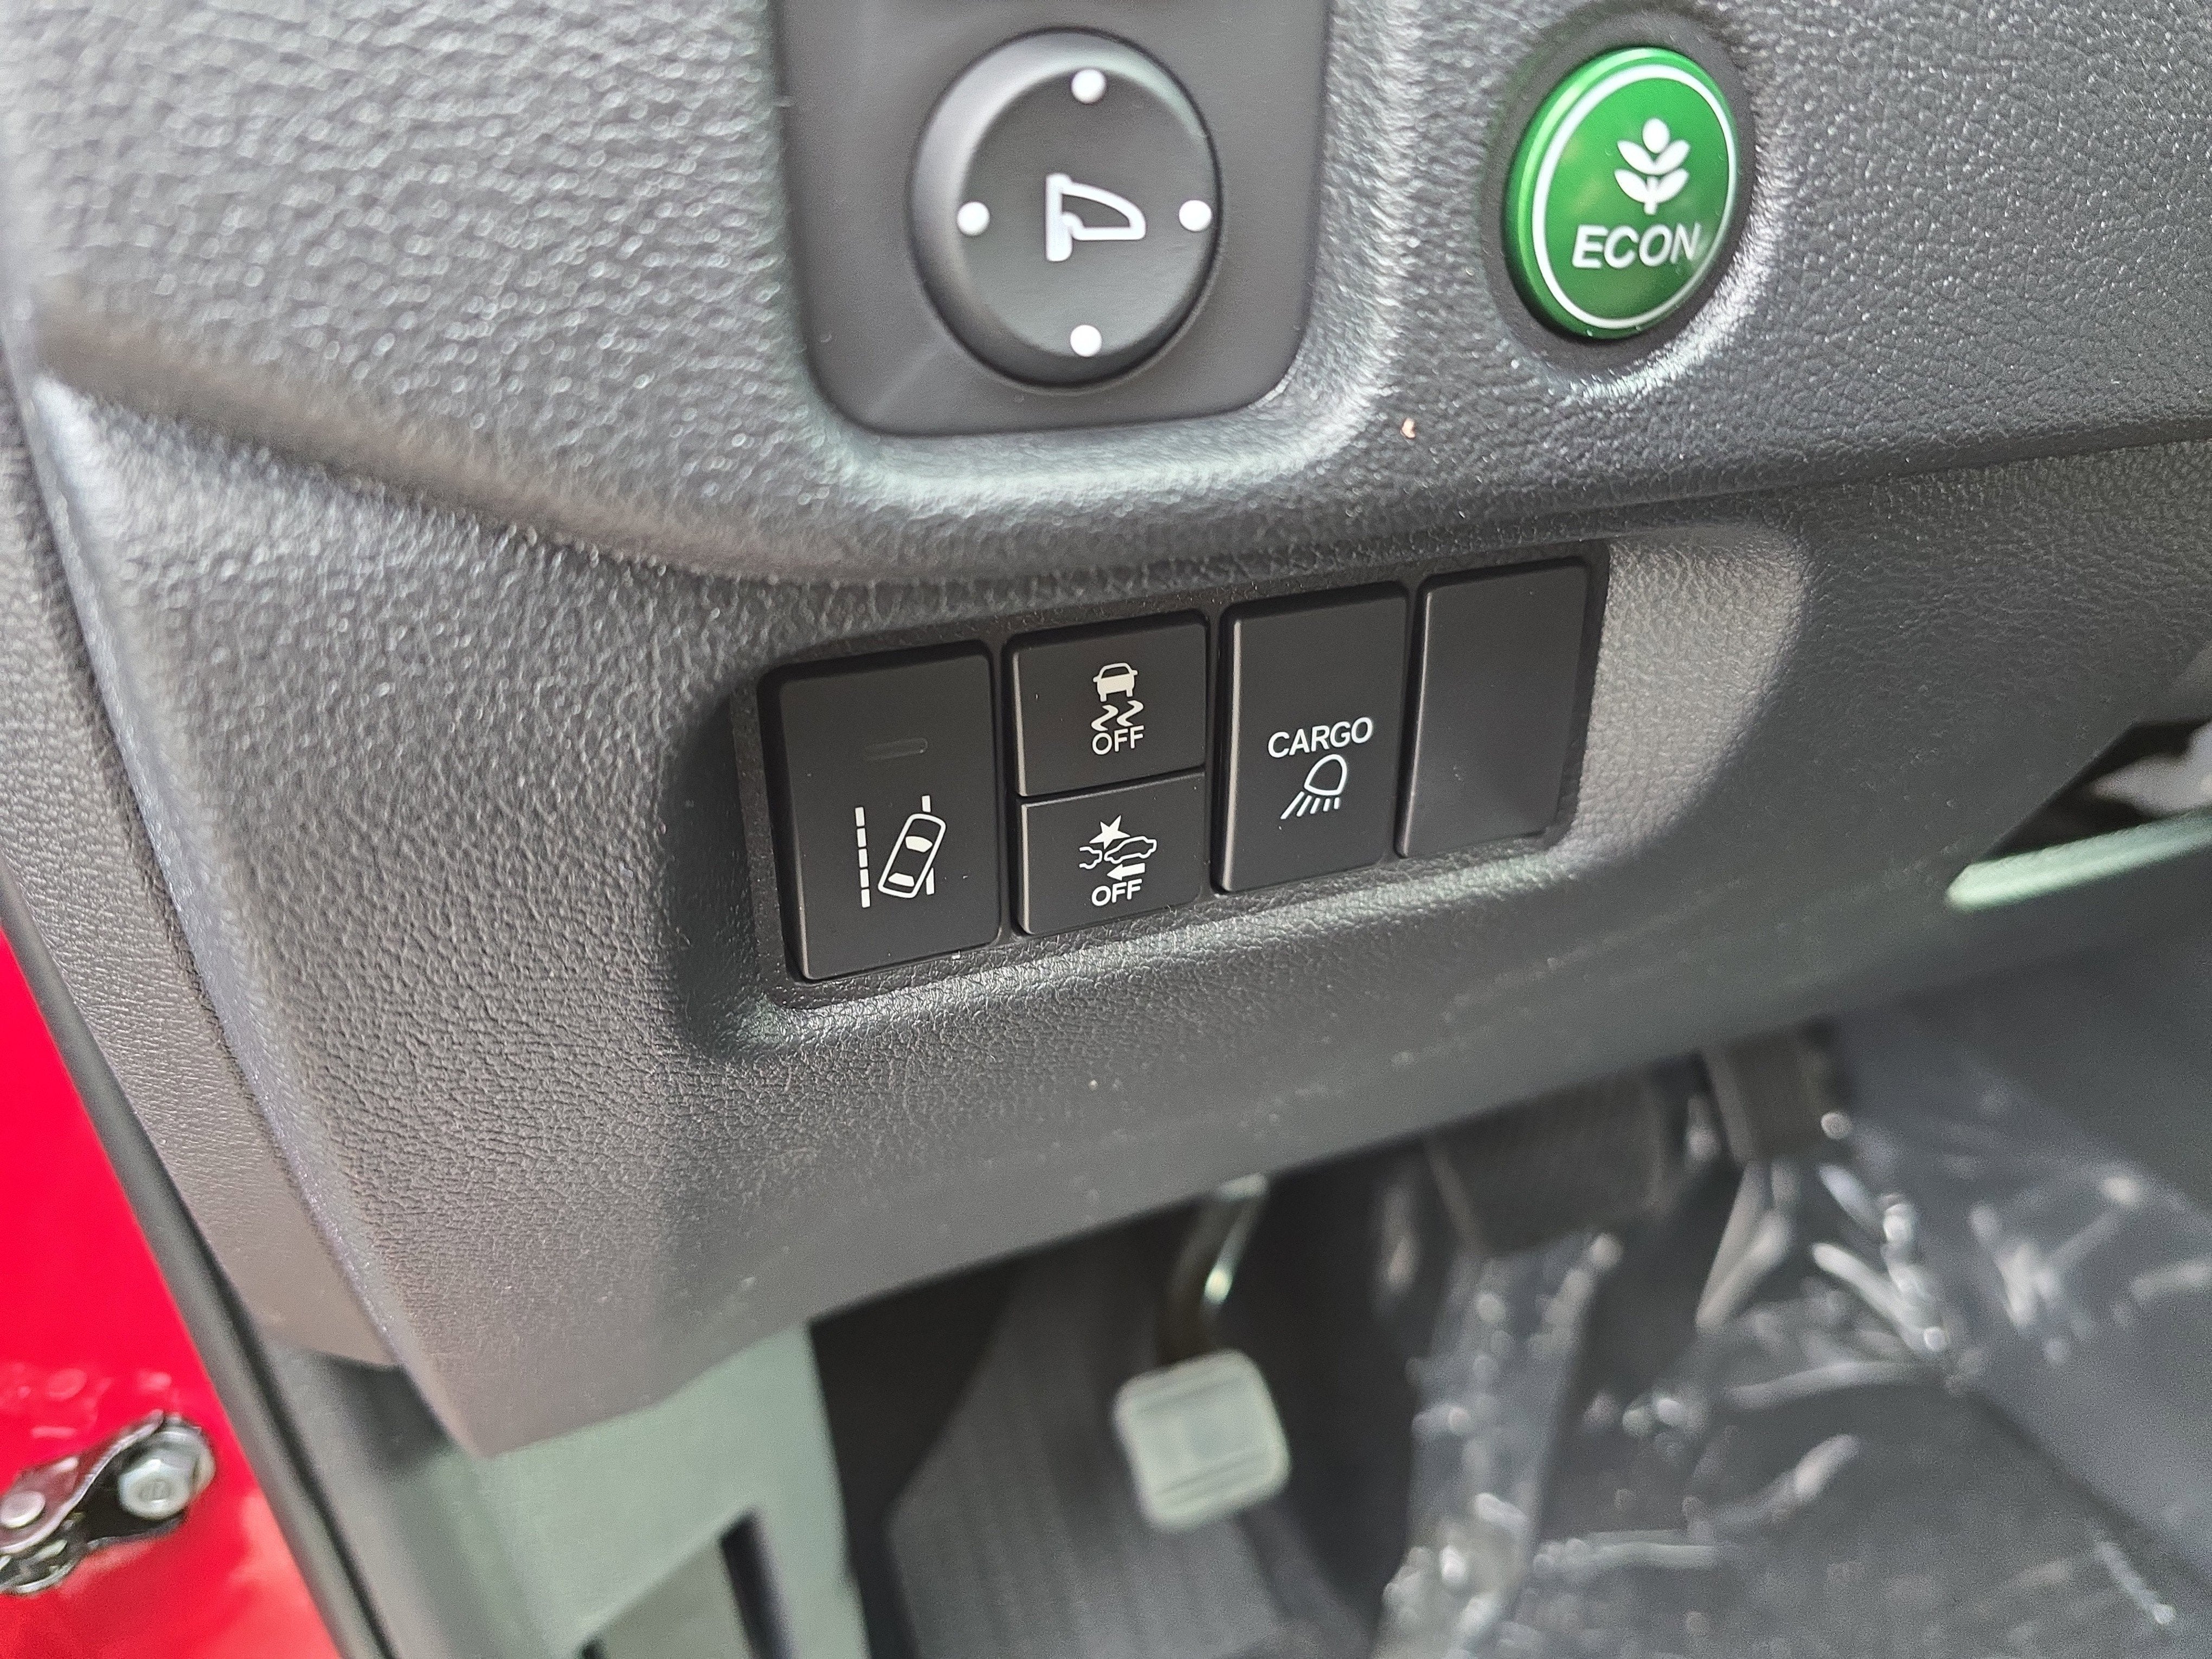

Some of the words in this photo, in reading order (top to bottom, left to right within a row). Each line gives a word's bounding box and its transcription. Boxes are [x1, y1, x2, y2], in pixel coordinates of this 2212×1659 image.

[1572, 222, 1702, 269] ECON
[1092, 725, 1144, 755] OFF
[1268, 717, 1373, 758] CARGO
[1091, 878, 1142, 907] OFF
